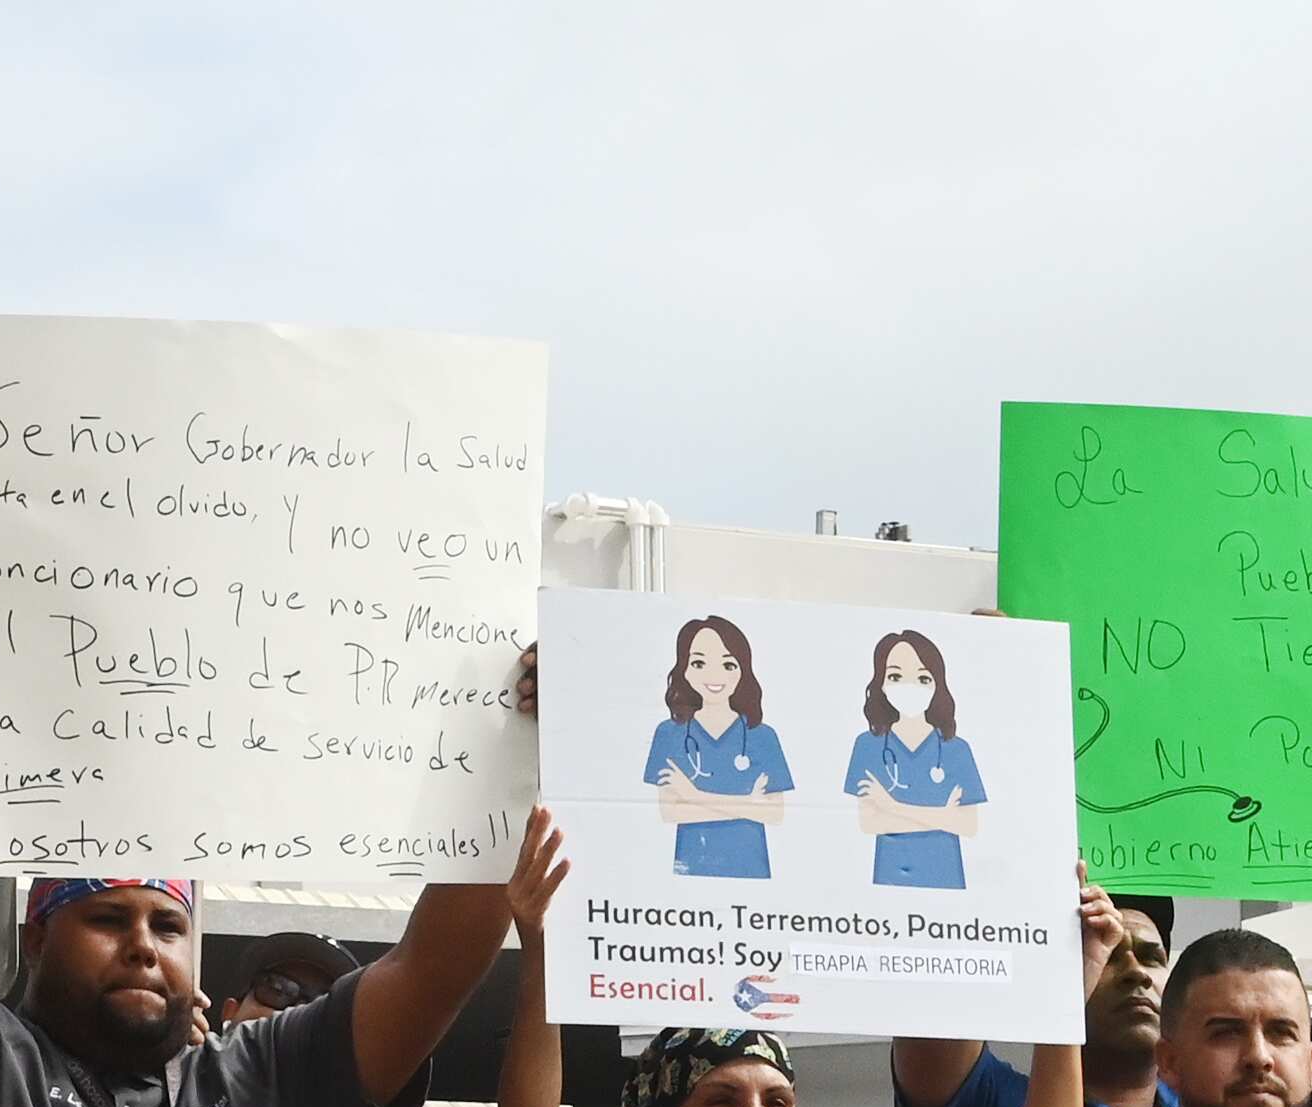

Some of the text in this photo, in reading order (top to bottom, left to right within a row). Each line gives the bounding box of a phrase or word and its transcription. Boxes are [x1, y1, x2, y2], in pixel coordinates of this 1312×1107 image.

[186, 411, 376, 472] Gobernador
[403, 421, 439, 473] la
[456, 434, 528, 472] Salud
[1053, 425, 1143, 509] La
[156, 484, 259, 523] olvido,
[329, 523, 370, 551] no
[396, 529, 468, 562] veo
[485, 537, 523, 565] un
[227, 583, 306, 626] que
[328, 597, 389, 621] nos
[404, 606, 527, 651] Mencione
[1102, 616, 1186, 674] NO
[50, 613, 217, 687] Pueblo
[248, 636, 308, 695] de
[242, 717, 278, 753] de
[302, 732, 414, 764] servicio
[427, 729, 475, 774] de
[184, 833, 311, 863] somos
[587, 899, 1049, 946] Huracan, Terremotos, Pandemia
[588, 936, 1007, 976] Traumas! Soy TERAPIA RESPIRATORIA
[589, 973, 714, 1002] Esencial.
